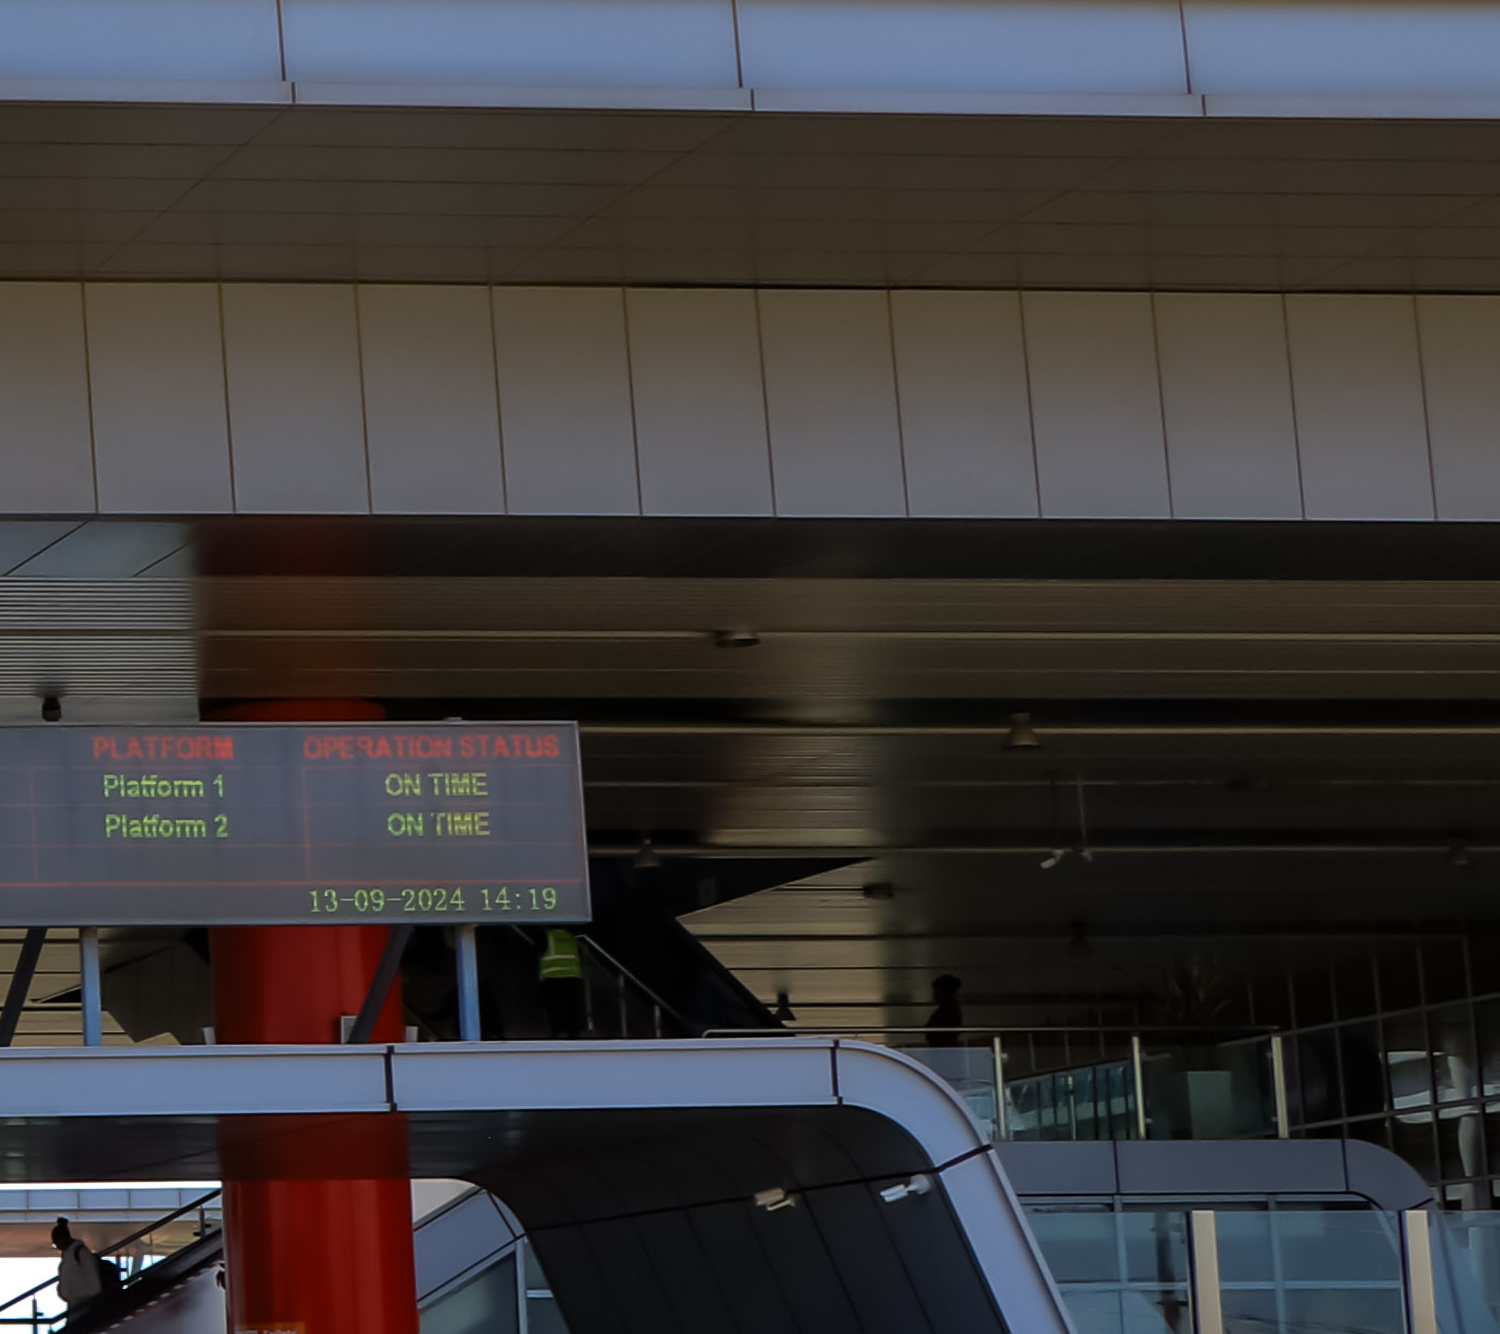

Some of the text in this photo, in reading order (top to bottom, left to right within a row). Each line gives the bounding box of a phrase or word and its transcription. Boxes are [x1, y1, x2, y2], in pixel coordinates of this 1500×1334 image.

[93, 736, 234, 760] PLATFORM
[303, 734, 560, 759] OPERATION STATUS
[103, 774, 224, 798] Platform 1
[384, 772, 488, 796] ON TIME
[105, 814, 229, 838] Platform 2
[387, 812, 490, 836] ON TIME
[308, 886, 557, 912] 13-09-2024 14:19
